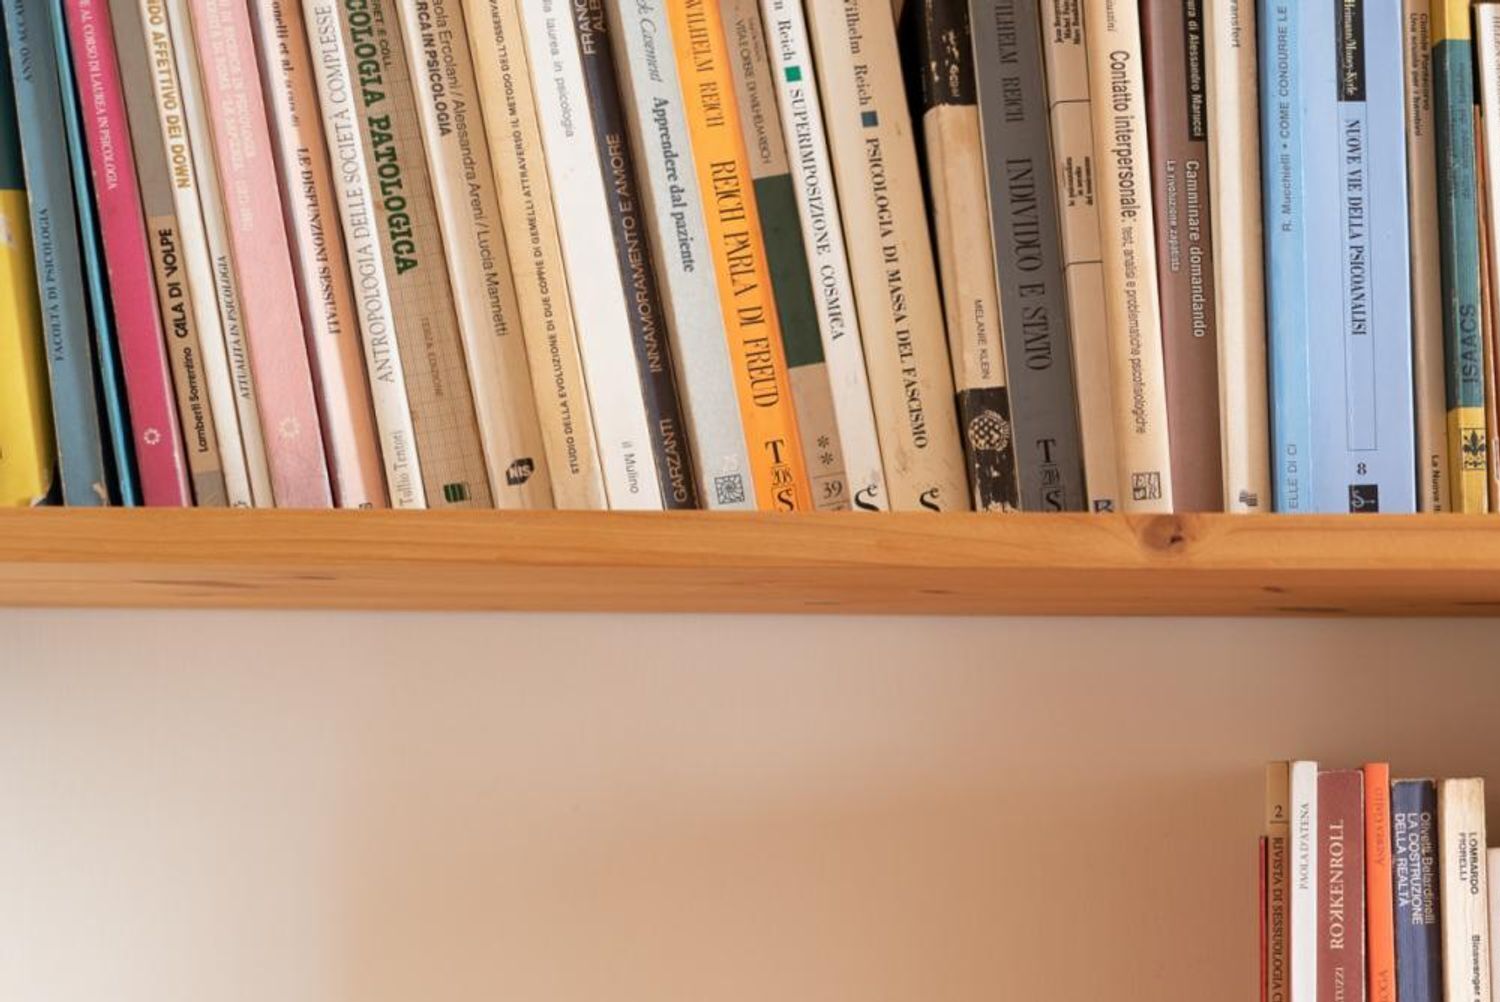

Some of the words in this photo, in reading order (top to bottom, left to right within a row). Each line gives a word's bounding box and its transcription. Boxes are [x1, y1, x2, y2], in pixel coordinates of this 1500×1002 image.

[150, 32, 179, 110] AFFETTIVO
[1110, 51, 1132, 111] Contatto
[163, 114, 183, 140] DEI
[297, 148, 313, 166] LE
[652, 97, 682, 181] Apprendere
[1345, 119, 1363, 163] NUOVE
[169, 145, 190, 189] DOWN
[365, 116, 418, 274] PATOLOGICA
[605, 134, 631, 196] AMORE
[710, 161, 747, 223] REICH
[865, 139, 895, 238] PSICOLOGIA
[1113, 116, 1137, 223] interpersonale:
[1346, 170, 1363, 191] VIE
[300, 170, 329, 264] DISFUNZIONI
[618, 203, 634, 212] E
[666, 185, 686, 208] dal
[788, 89, 830, 255] SUPERIMPOSIZIONE
[818, 266, 844, 340] COSMICA
[1005, 159, 1043, 271] INDIVIDUO
[1186, 161, 1203, 241] Camminare
[1347, 196, 1364, 238] DELLA
[157, 229, 179, 275] VOLPE
[670, 212, 696, 272] paziente
[723, 233, 760, 298] PARLA
[882, 246, 899, 263] DI
[165, 282, 182, 298] DI
[317, 268, 341, 335] SESSUALI
[620, 217, 662, 373] INNAMORAMENTO
[737, 306, 765, 327] DI
[885, 270, 908, 322] MASSA
[1018, 284, 1045, 297] E
[1189, 247, 1206, 337] domandando
[1348, 245, 1367, 335] PSICOANALISI
[169, 304, 188, 338] CALA
[895, 331, 915, 363] DEL
[974, 299, 987, 345] MELANIE
[1020, 308, 1053, 370] STATO
[743, 340, 779, 407] FREUD
[978, 349, 991, 379] KLEIN
[900, 369, 928, 449] FASCISMO
[660, 418, 687, 502] GARZANTI
[1408, 813, 1419, 828] LA
[1272, 837, 1283, 885] RIVISTA
[1409, 833, 1422, 924] COSTRUZIONE
[1469, 833, 1479, 894] LOMBARDO
[1272, 889, 1283, 902] DI
[1272, 906, 1283, 990] SESSUOLOGIA
